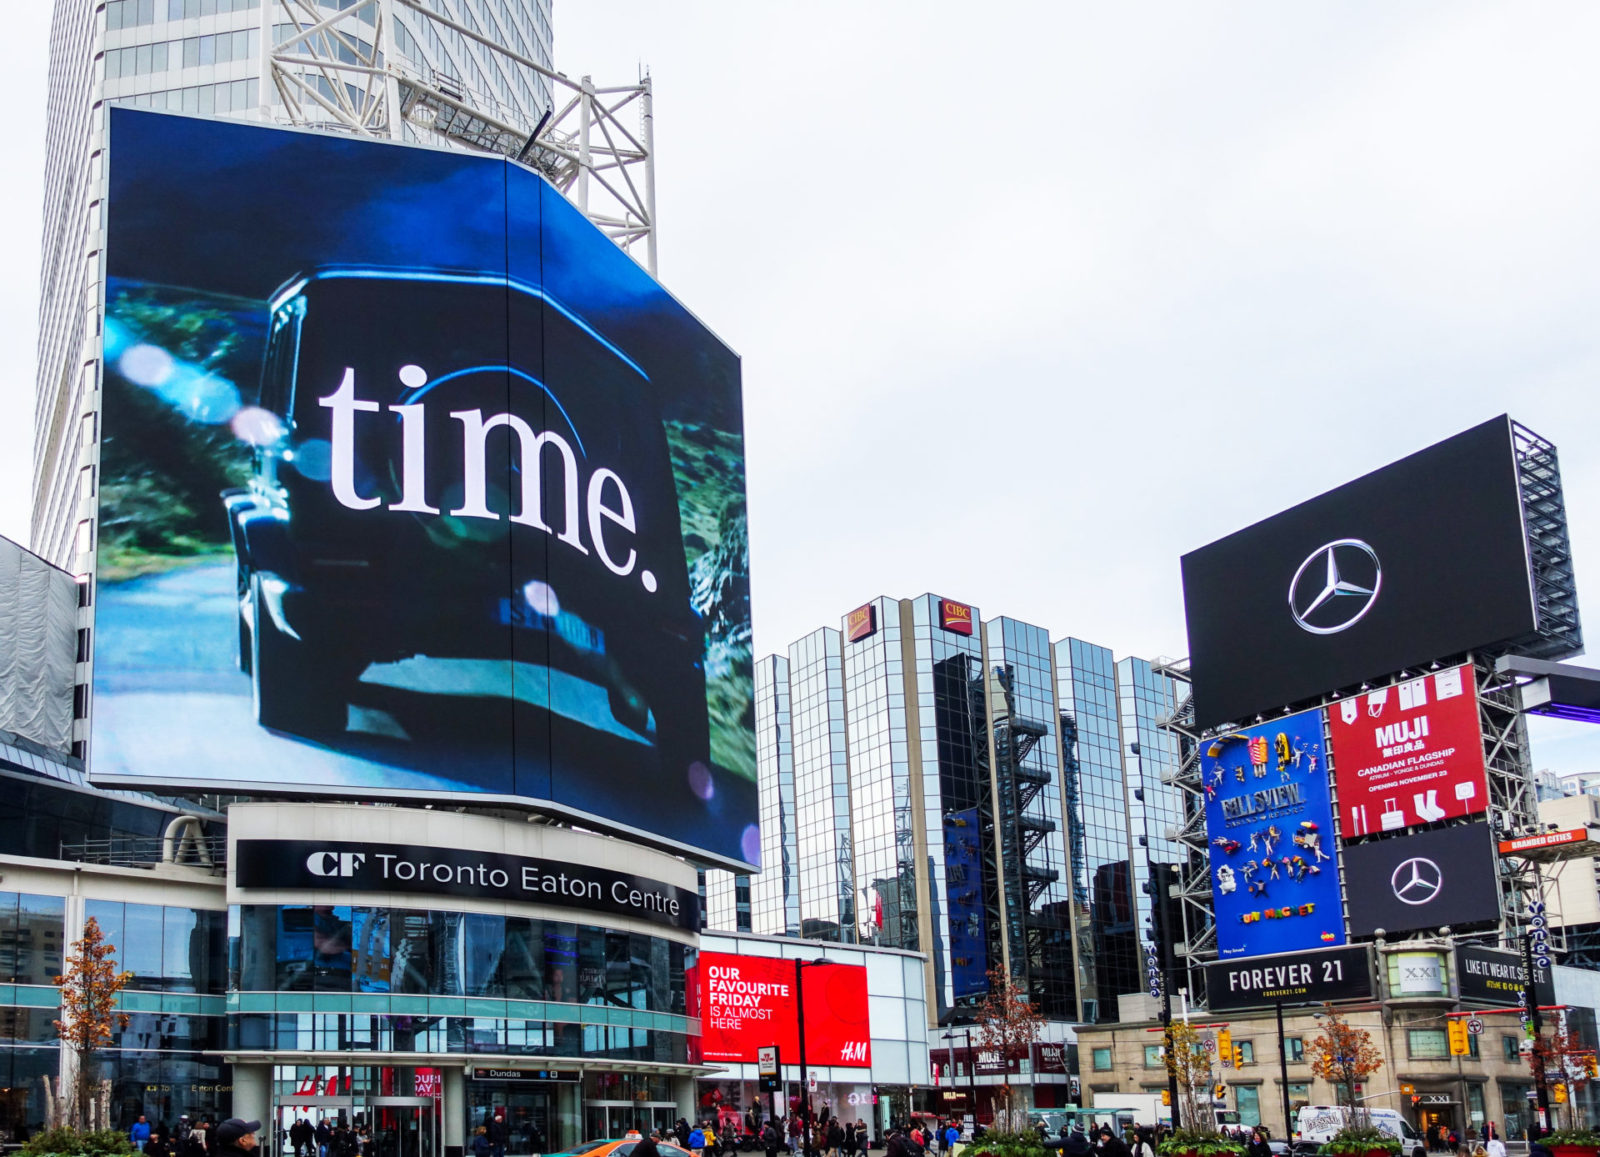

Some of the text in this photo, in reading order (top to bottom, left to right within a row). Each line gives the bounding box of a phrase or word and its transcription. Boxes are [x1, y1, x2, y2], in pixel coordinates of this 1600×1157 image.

[319, 364, 657, 593] time.
[848, 607, 868, 625] CIBC
[945, 602, 970, 618] CIBC
[1375, 715, 1429, 748] MUJI
[1357, 747, 1455, 777] CANADIAN FLAGSHIP
[1369, 772, 1390, 781] ATRIUM
[1394, 767, 1414, 776] YONGE
[1420, 760, 1444, 770] DUNDAS
[1368, 781, 1398, 792] OPENING
[1400, 772, 1438, 786] NOVEMBER
[1220, 782, 1300, 820] FALLSVIEW
[1512, 832, 1572, 849] BRANDED CITIES
[306, 851, 681, 916] CF Toronto Eaton Centre
[1237, 903, 1316, 924] FUN MAGNET
[708, 966, 740, 980] OUR
[1228, 960, 1343, 992] FOREVER 21
[1404, 967, 1438, 978] XXI
[1465, 958, 1482, 975] LIKE
[1490, 962, 1510, 979] WEAR
[709, 979, 790, 997] FAVOURITE
[1262, 987, 1307, 998] FOREVER21.COM
[710, 992, 761, 1008] FRIDAY
[710, 1006, 773, 1020] IS ALMOST
[710, 1018, 742, 1030] HERE
[840, 1041, 867, 1062] H&M
[978, 1050, 1000, 1063] MUJI
[1042, 1047, 1060, 1057] MUJI
[490, 1070, 520, 1078] Dundas
[1430, 1096, 1450, 1104] XXI
